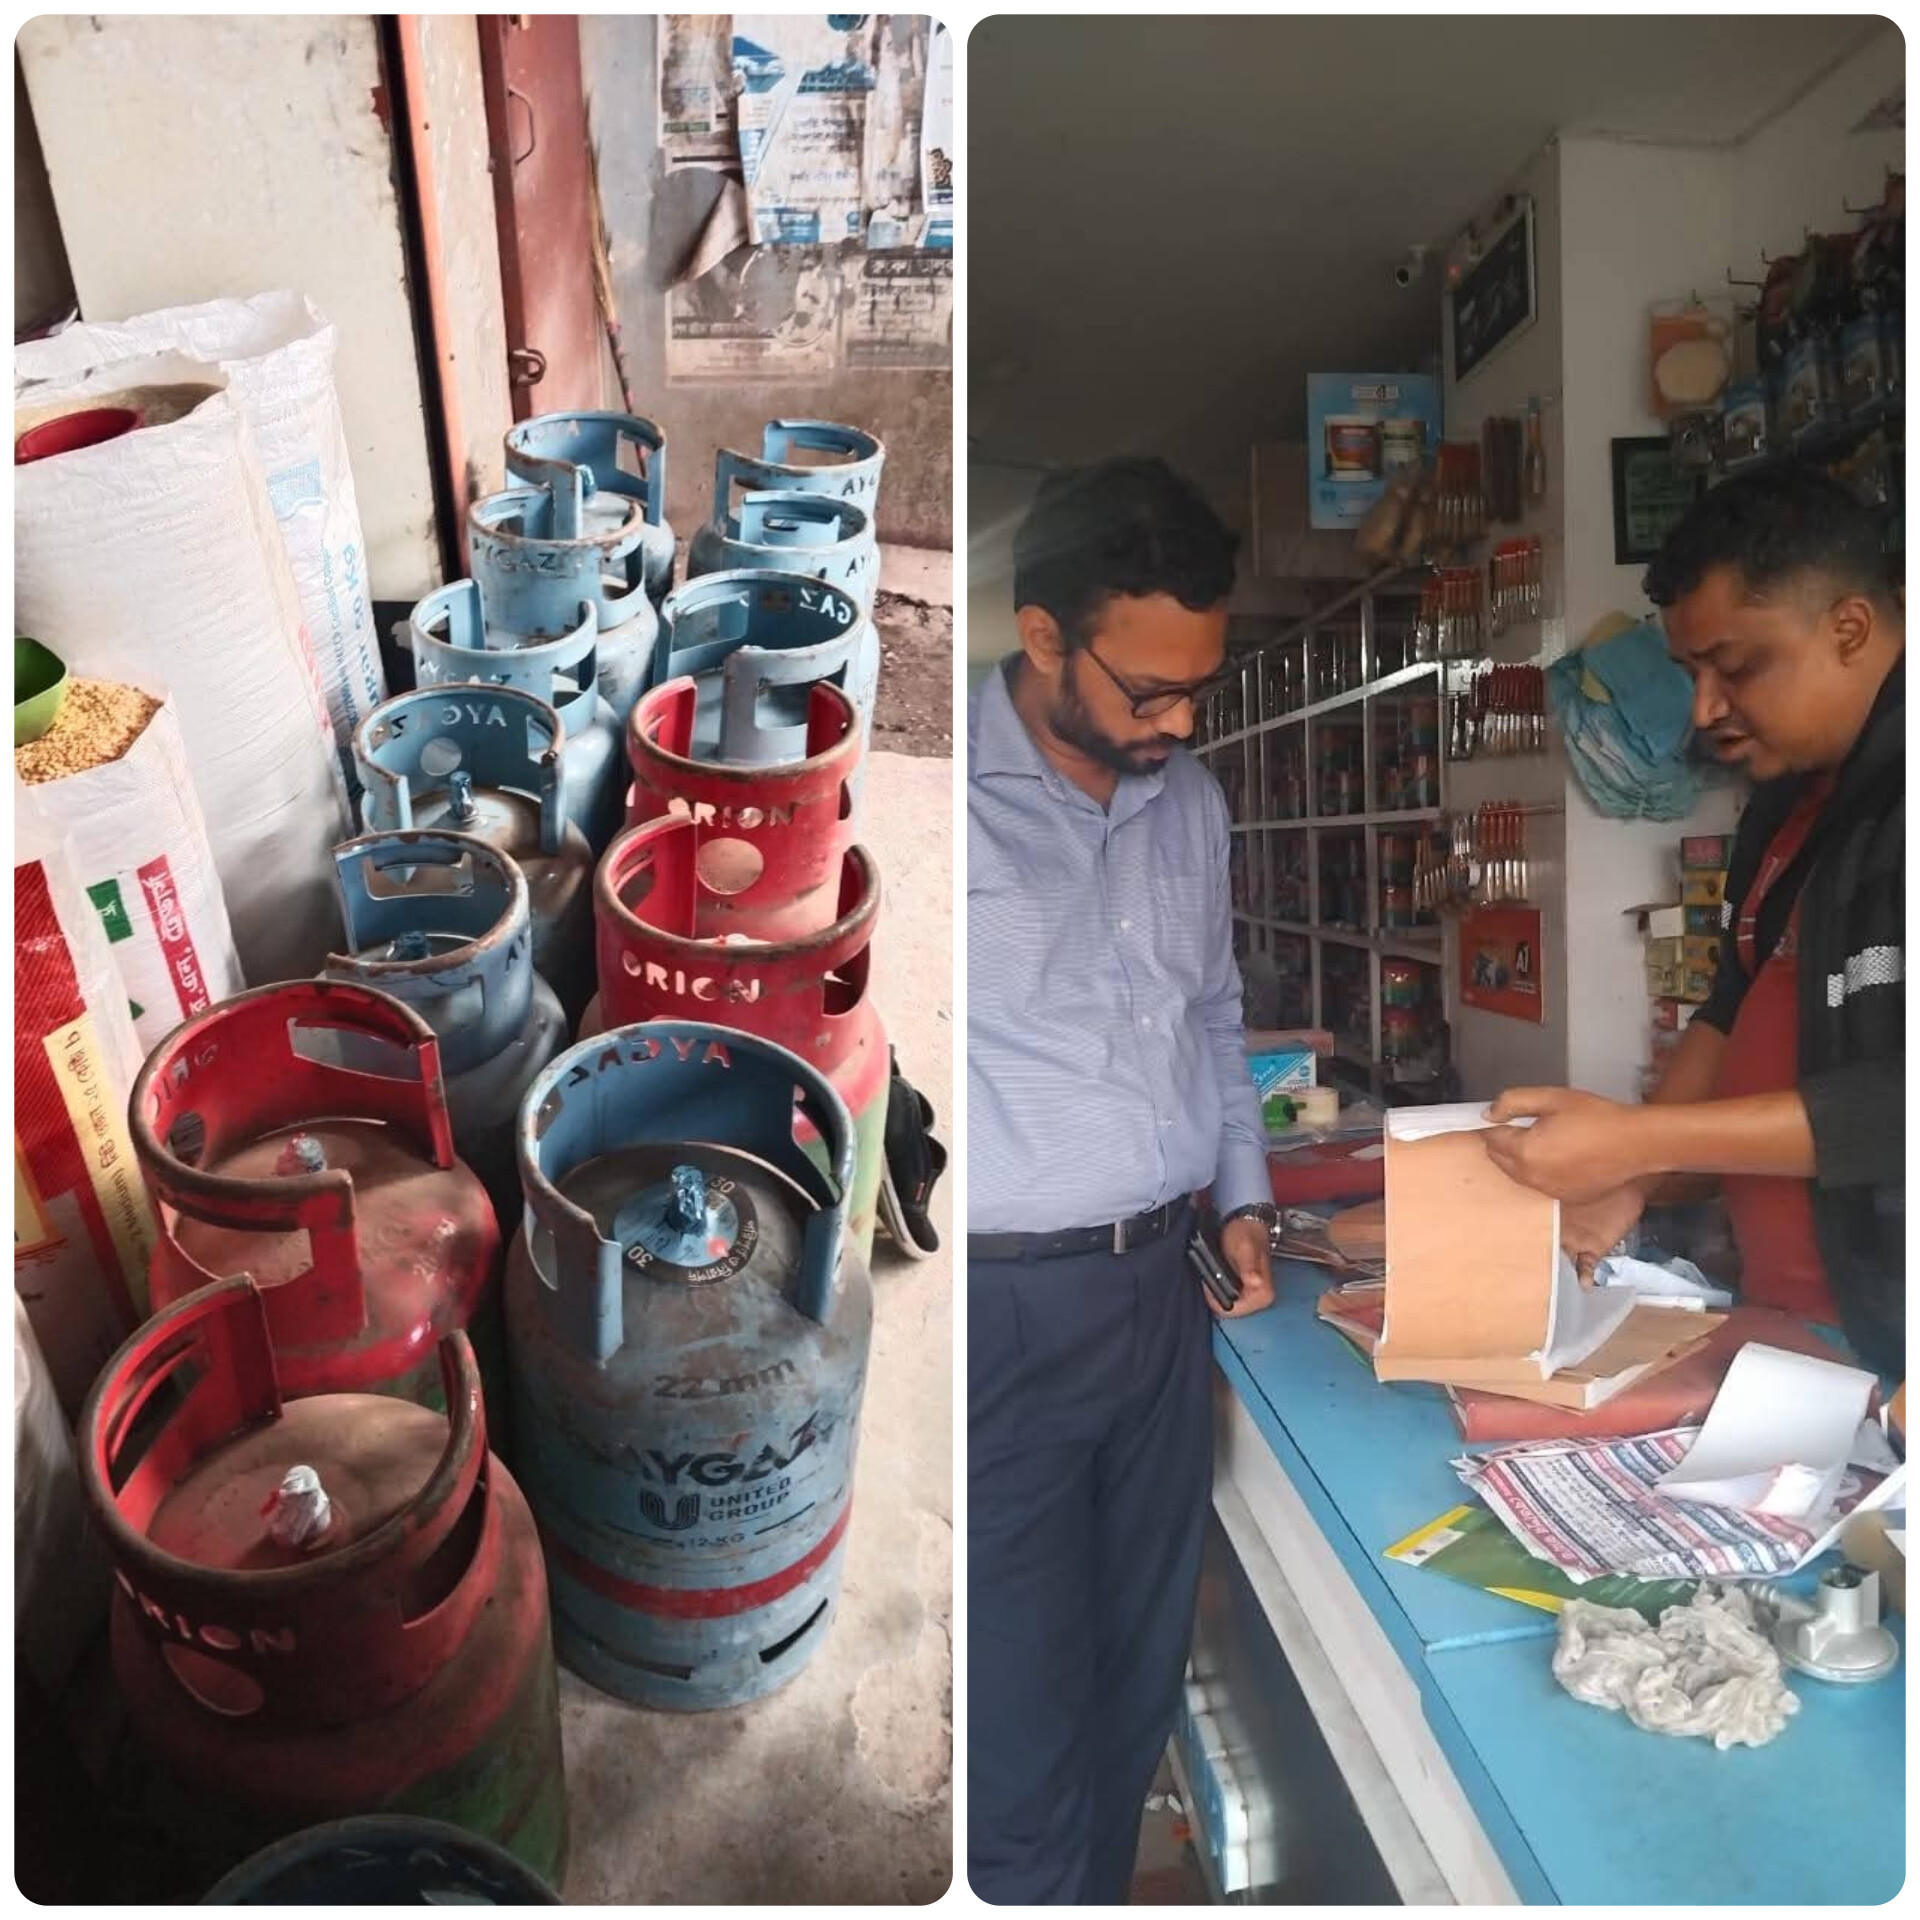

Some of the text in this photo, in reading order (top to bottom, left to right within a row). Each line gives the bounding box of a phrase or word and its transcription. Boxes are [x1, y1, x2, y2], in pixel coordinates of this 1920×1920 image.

[667, 796, 796, 829] ORION
[622, 950, 762, 1004] ORION
[710, 1176, 736, 1194] 30
[627, 1245, 654, 1268] 30
[720, 1358, 796, 1395] mm
[640, 1409, 836, 1487] YGAZ
[708, 1491, 790, 1522] GROUP
[709, 1476, 792, 1508] UNITED
